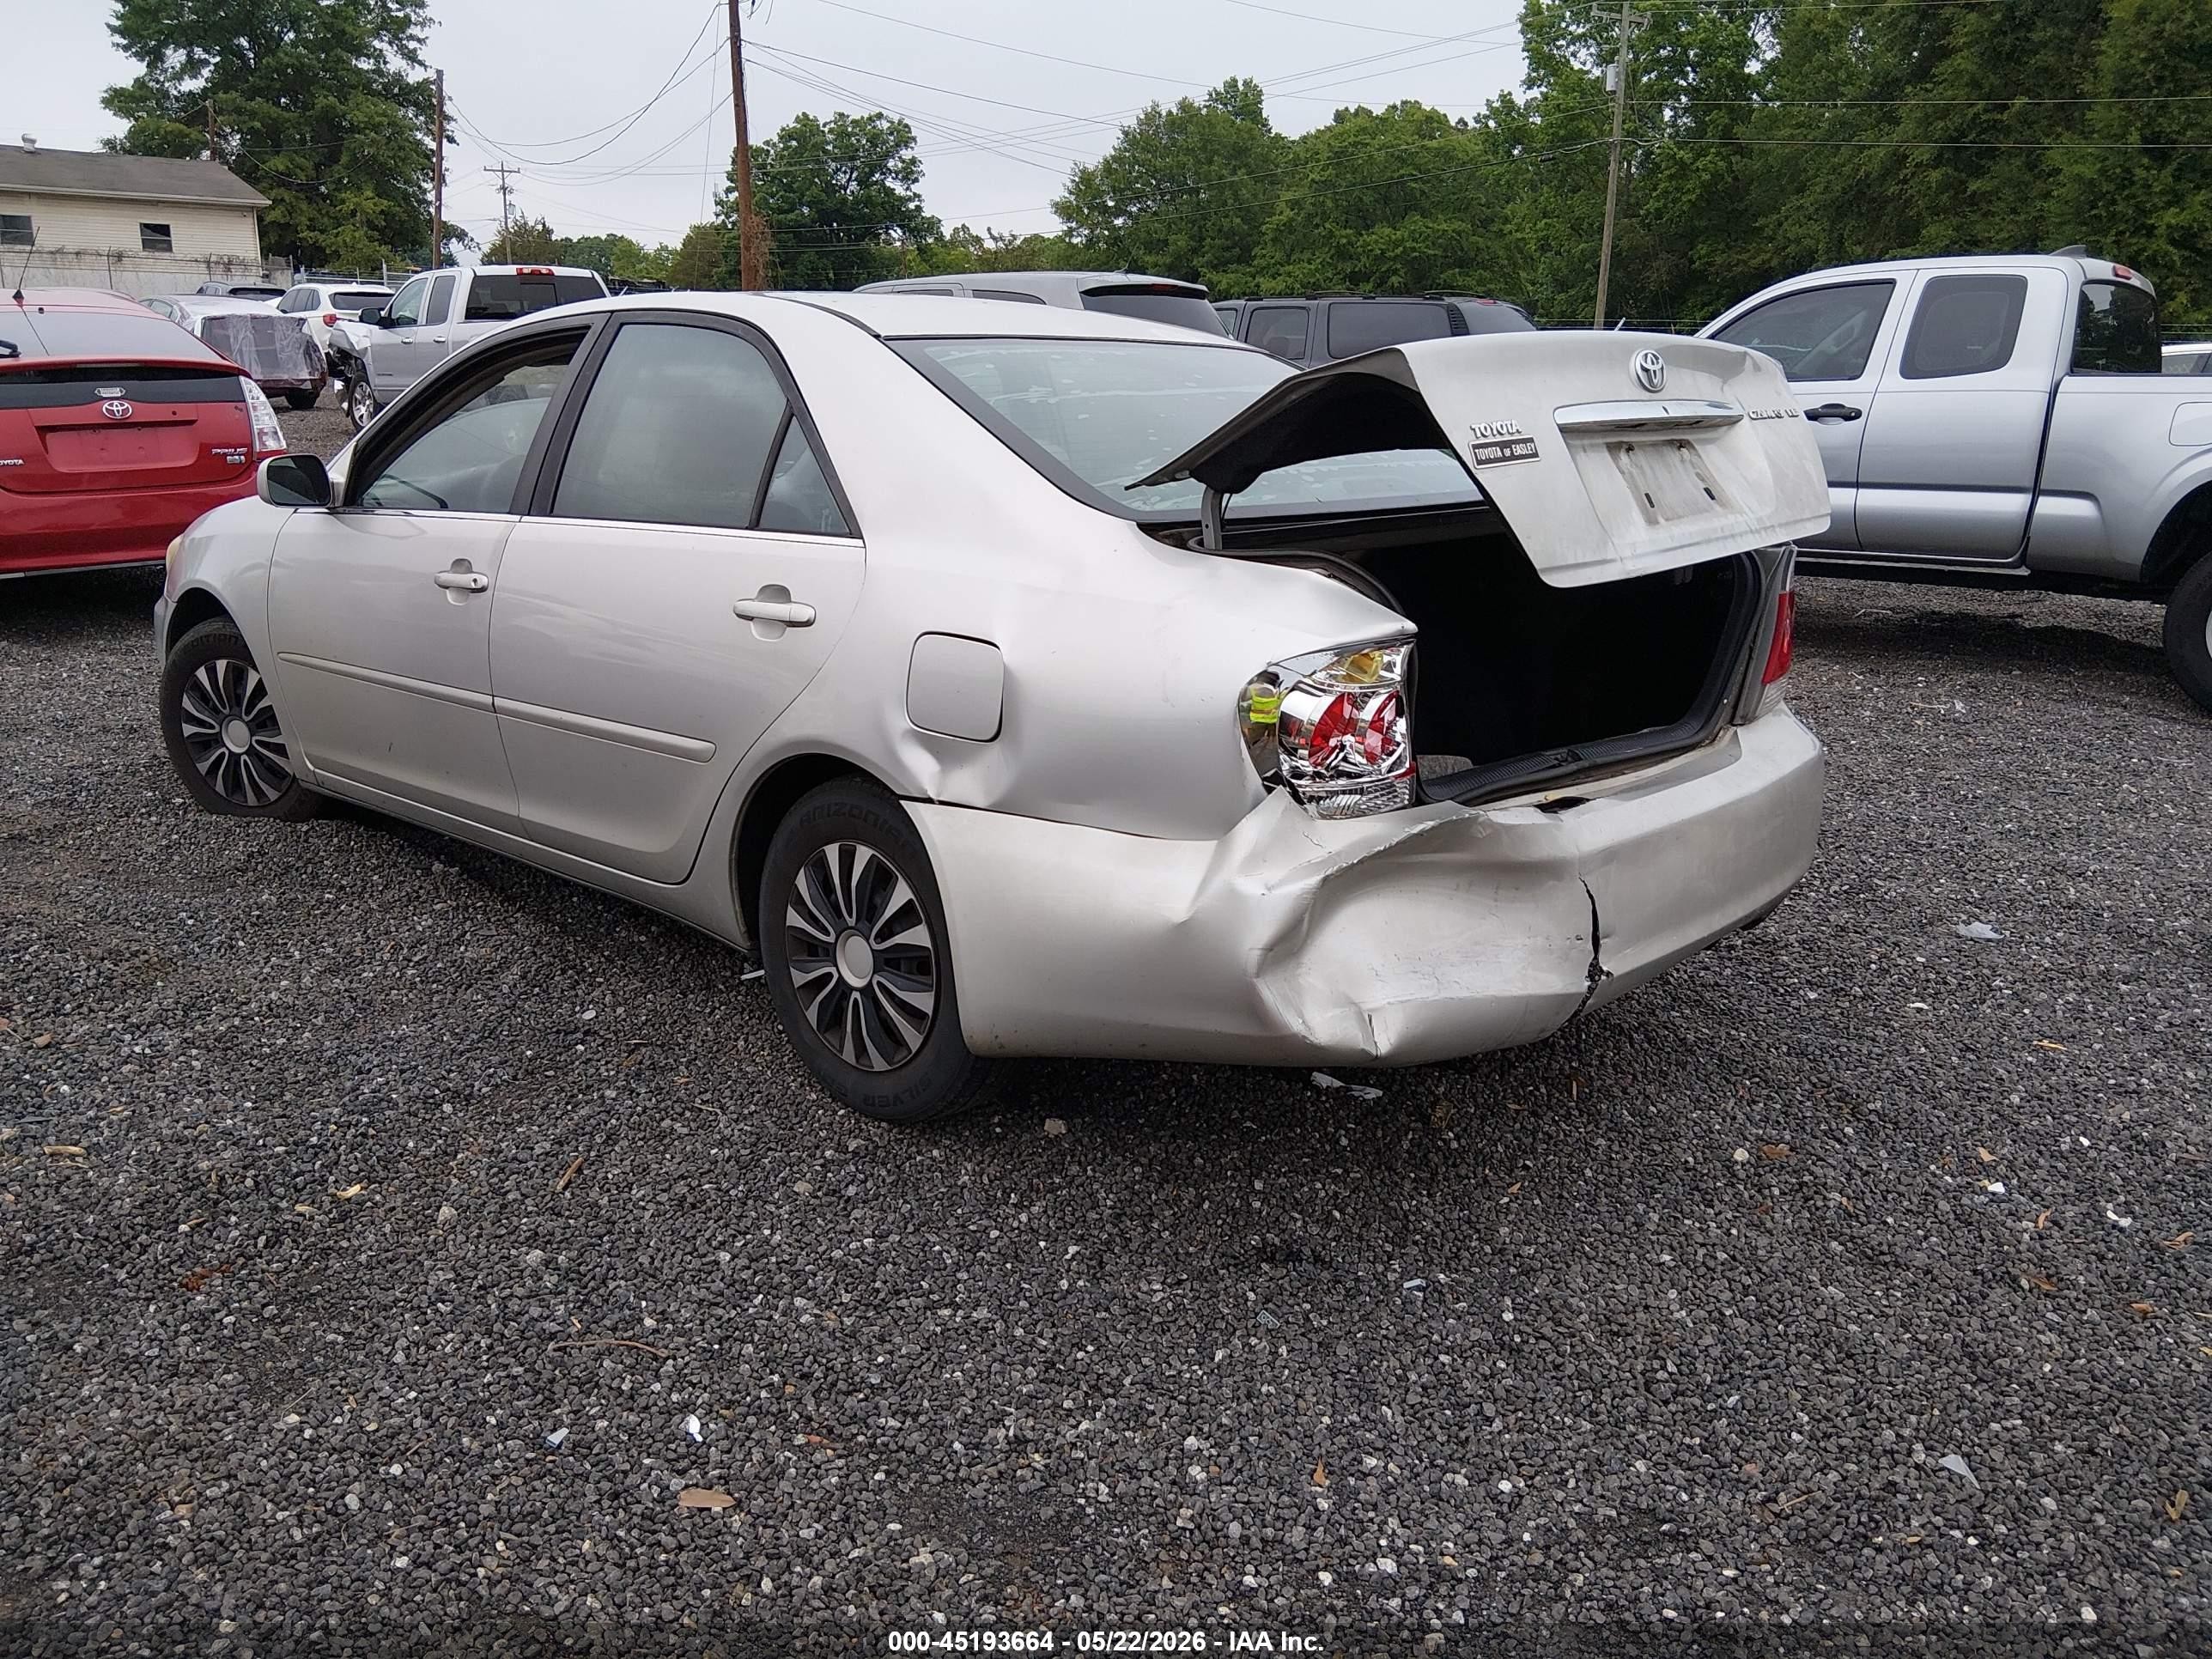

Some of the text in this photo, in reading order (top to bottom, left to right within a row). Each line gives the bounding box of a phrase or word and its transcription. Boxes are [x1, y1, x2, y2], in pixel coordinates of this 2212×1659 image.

[1470, 420, 1522, 439] TOYOTA
[1474, 442, 1535, 460] TOYOTA OF EASLEY
